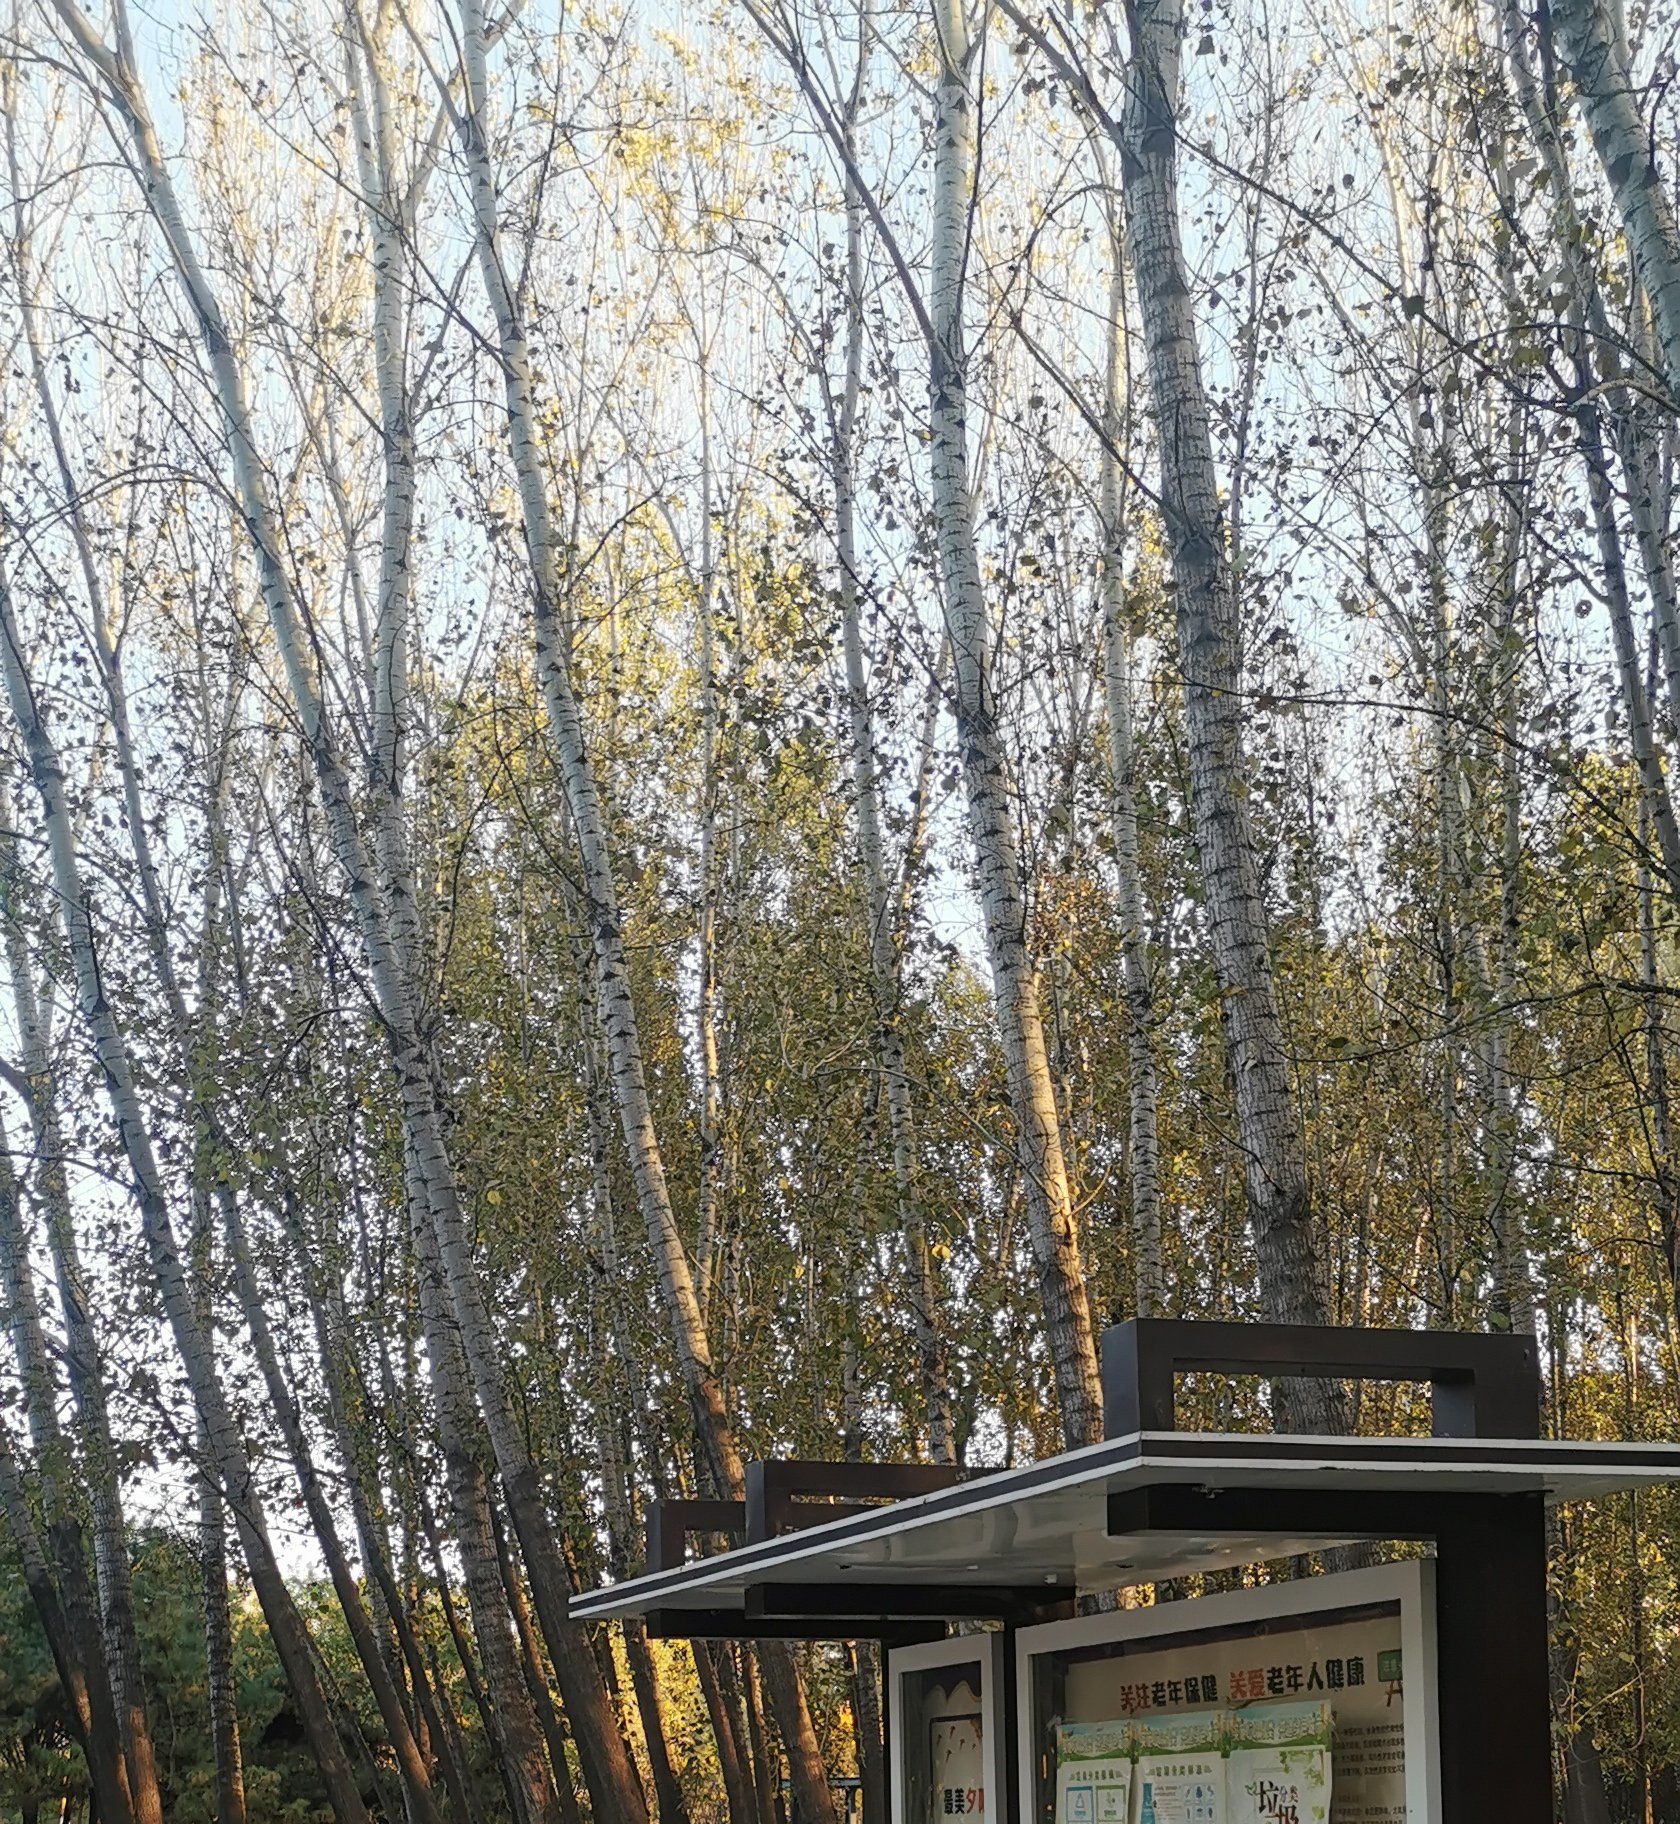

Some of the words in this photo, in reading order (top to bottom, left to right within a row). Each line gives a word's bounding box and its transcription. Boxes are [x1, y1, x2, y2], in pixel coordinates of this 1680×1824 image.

[1119, 1674, 1218, 1711] 关注老年保健
[1229, 1656, 1365, 1699] 关爱老年人健康
